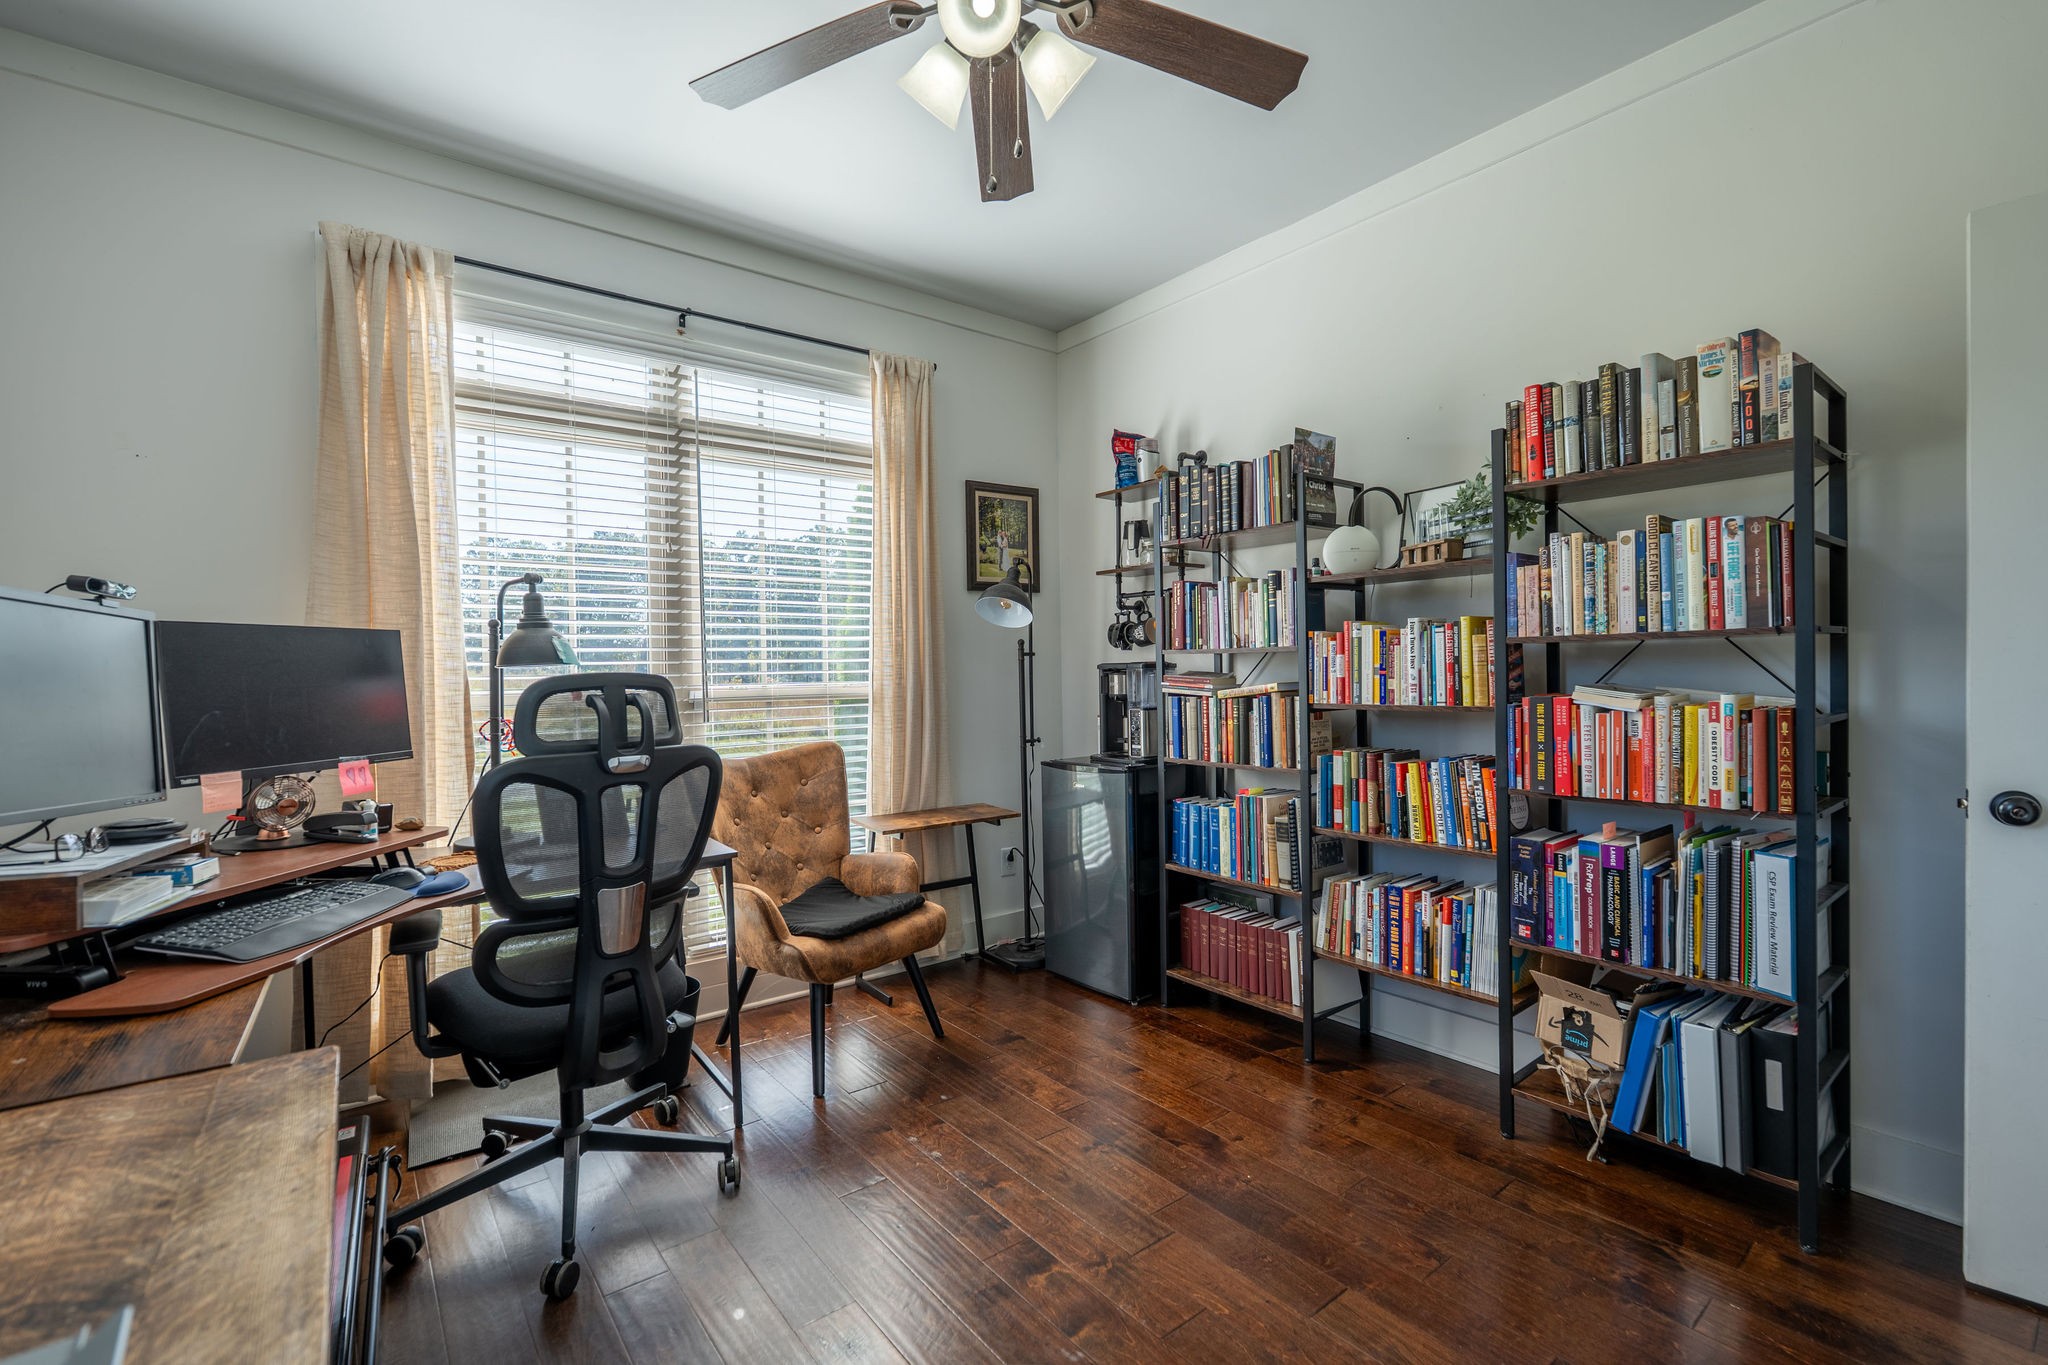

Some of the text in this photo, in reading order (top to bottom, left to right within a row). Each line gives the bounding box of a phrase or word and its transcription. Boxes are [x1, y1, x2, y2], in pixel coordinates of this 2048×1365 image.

[1698, 341, 1726, 354] Caribbean
[1700, 350, 1718, 361] James
[1742, 336, 1753, 352] JAMES
[1698, 356, 1726, 368] Michener
[1602, 368, 1612, 415] THE FIRM
[1530, 388, 1539, 438] MICHAEL CRICHTON
[1683, 405, 1691, 418] JOHN
[1732, 404, 1740, 429] JOURNEY
[1744, 391, 1753, 430] ZOO
[1308, 480, 1327, 491] Christ
[1552, 536, 1560, 568] Disease
[1648, 516, 1659, 593] GOOD CLEAN FUN
[1727, 542, 1741, 581] LIFE FORCE
[1446, 630, 1454, 664] RELENTLESS
[1537, 704, 1545, 719] TOOLS
[1726, 716, 1734, 730] Good
[1537, 726, 1545, 742] TITANS
[1656, 714, 1666, 782] Atomic Habits
[1672, 710, 1681, 769] SLOW PRODUCTIVITY
[1725, 730, 1734, 761] Productivity
[1584, 724, 1592, 784] EYES WIDE OPEN
[1643, 746, 1651, 766] Anxiety
[1563, 767, 1567, 775] OF
[1433, 778, 1441, 812] SECOND
[1460, 780, 1468, 807] SHAKEN
[1472, 763, 1485, 819] TIM TEBOW
[1585, 863, 1594, 894] RxPrep
[1768, 871, 1777, 886] CSP
[1390, 908, 1399, 959] THE 4-HOUR BODY
[1770, 911, 1778, 940] Review
[1771, 942, 1779, 976] Material
[1565, 1034, 1589, 1049] prime
